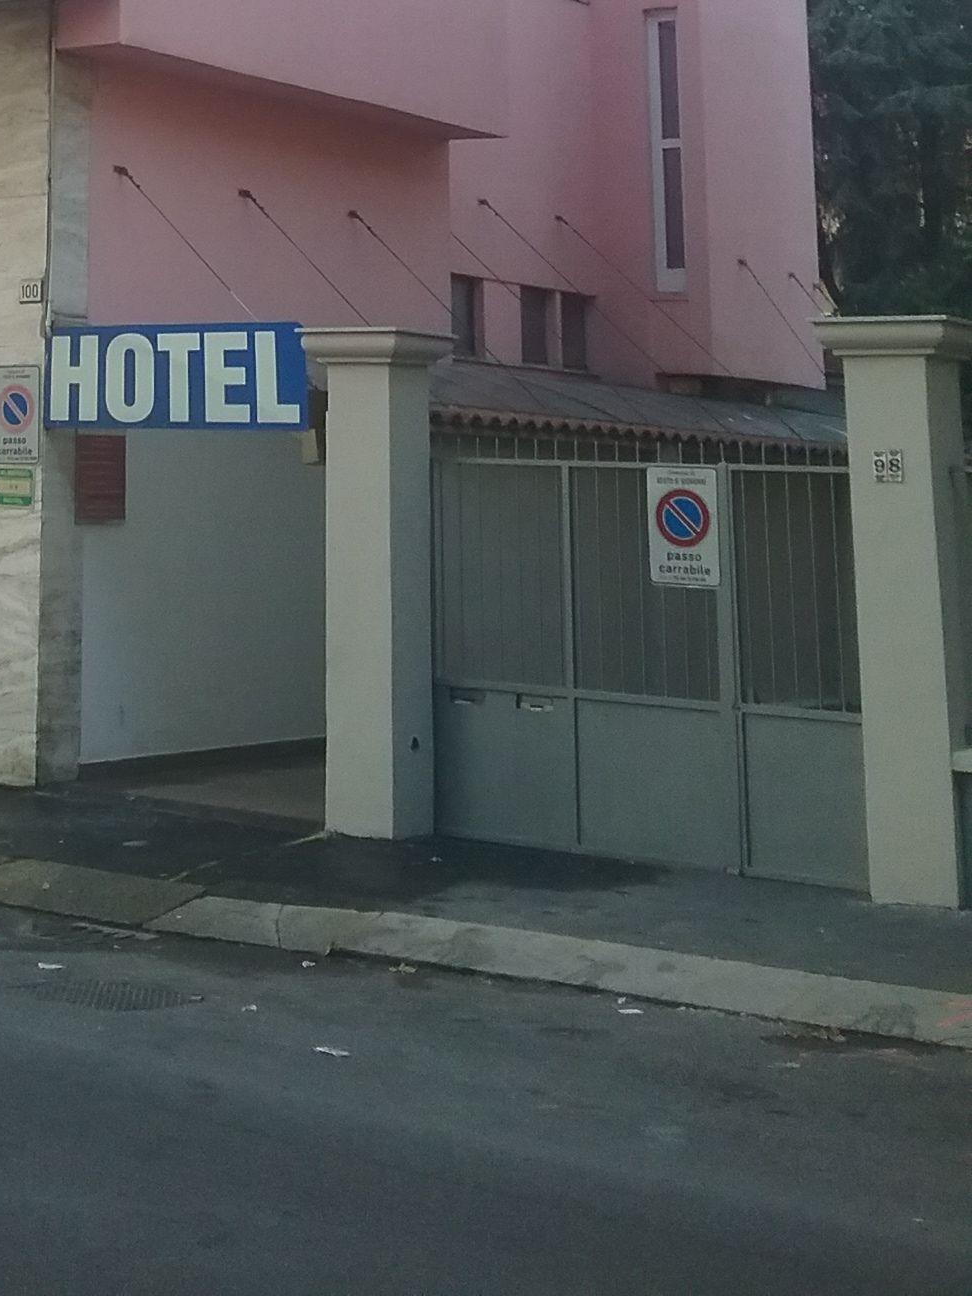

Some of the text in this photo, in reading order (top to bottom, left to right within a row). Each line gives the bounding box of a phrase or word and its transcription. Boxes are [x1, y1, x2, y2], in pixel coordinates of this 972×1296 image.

[21, 284, 38, 299] 100
[49, 331, 300, 424] HOTEL
[2, 436, 27, 445] passo
[874, 458, 901, 473] 98
[666, 552, 702, 562] passo
[659, 564, 711, 576] carrabile
